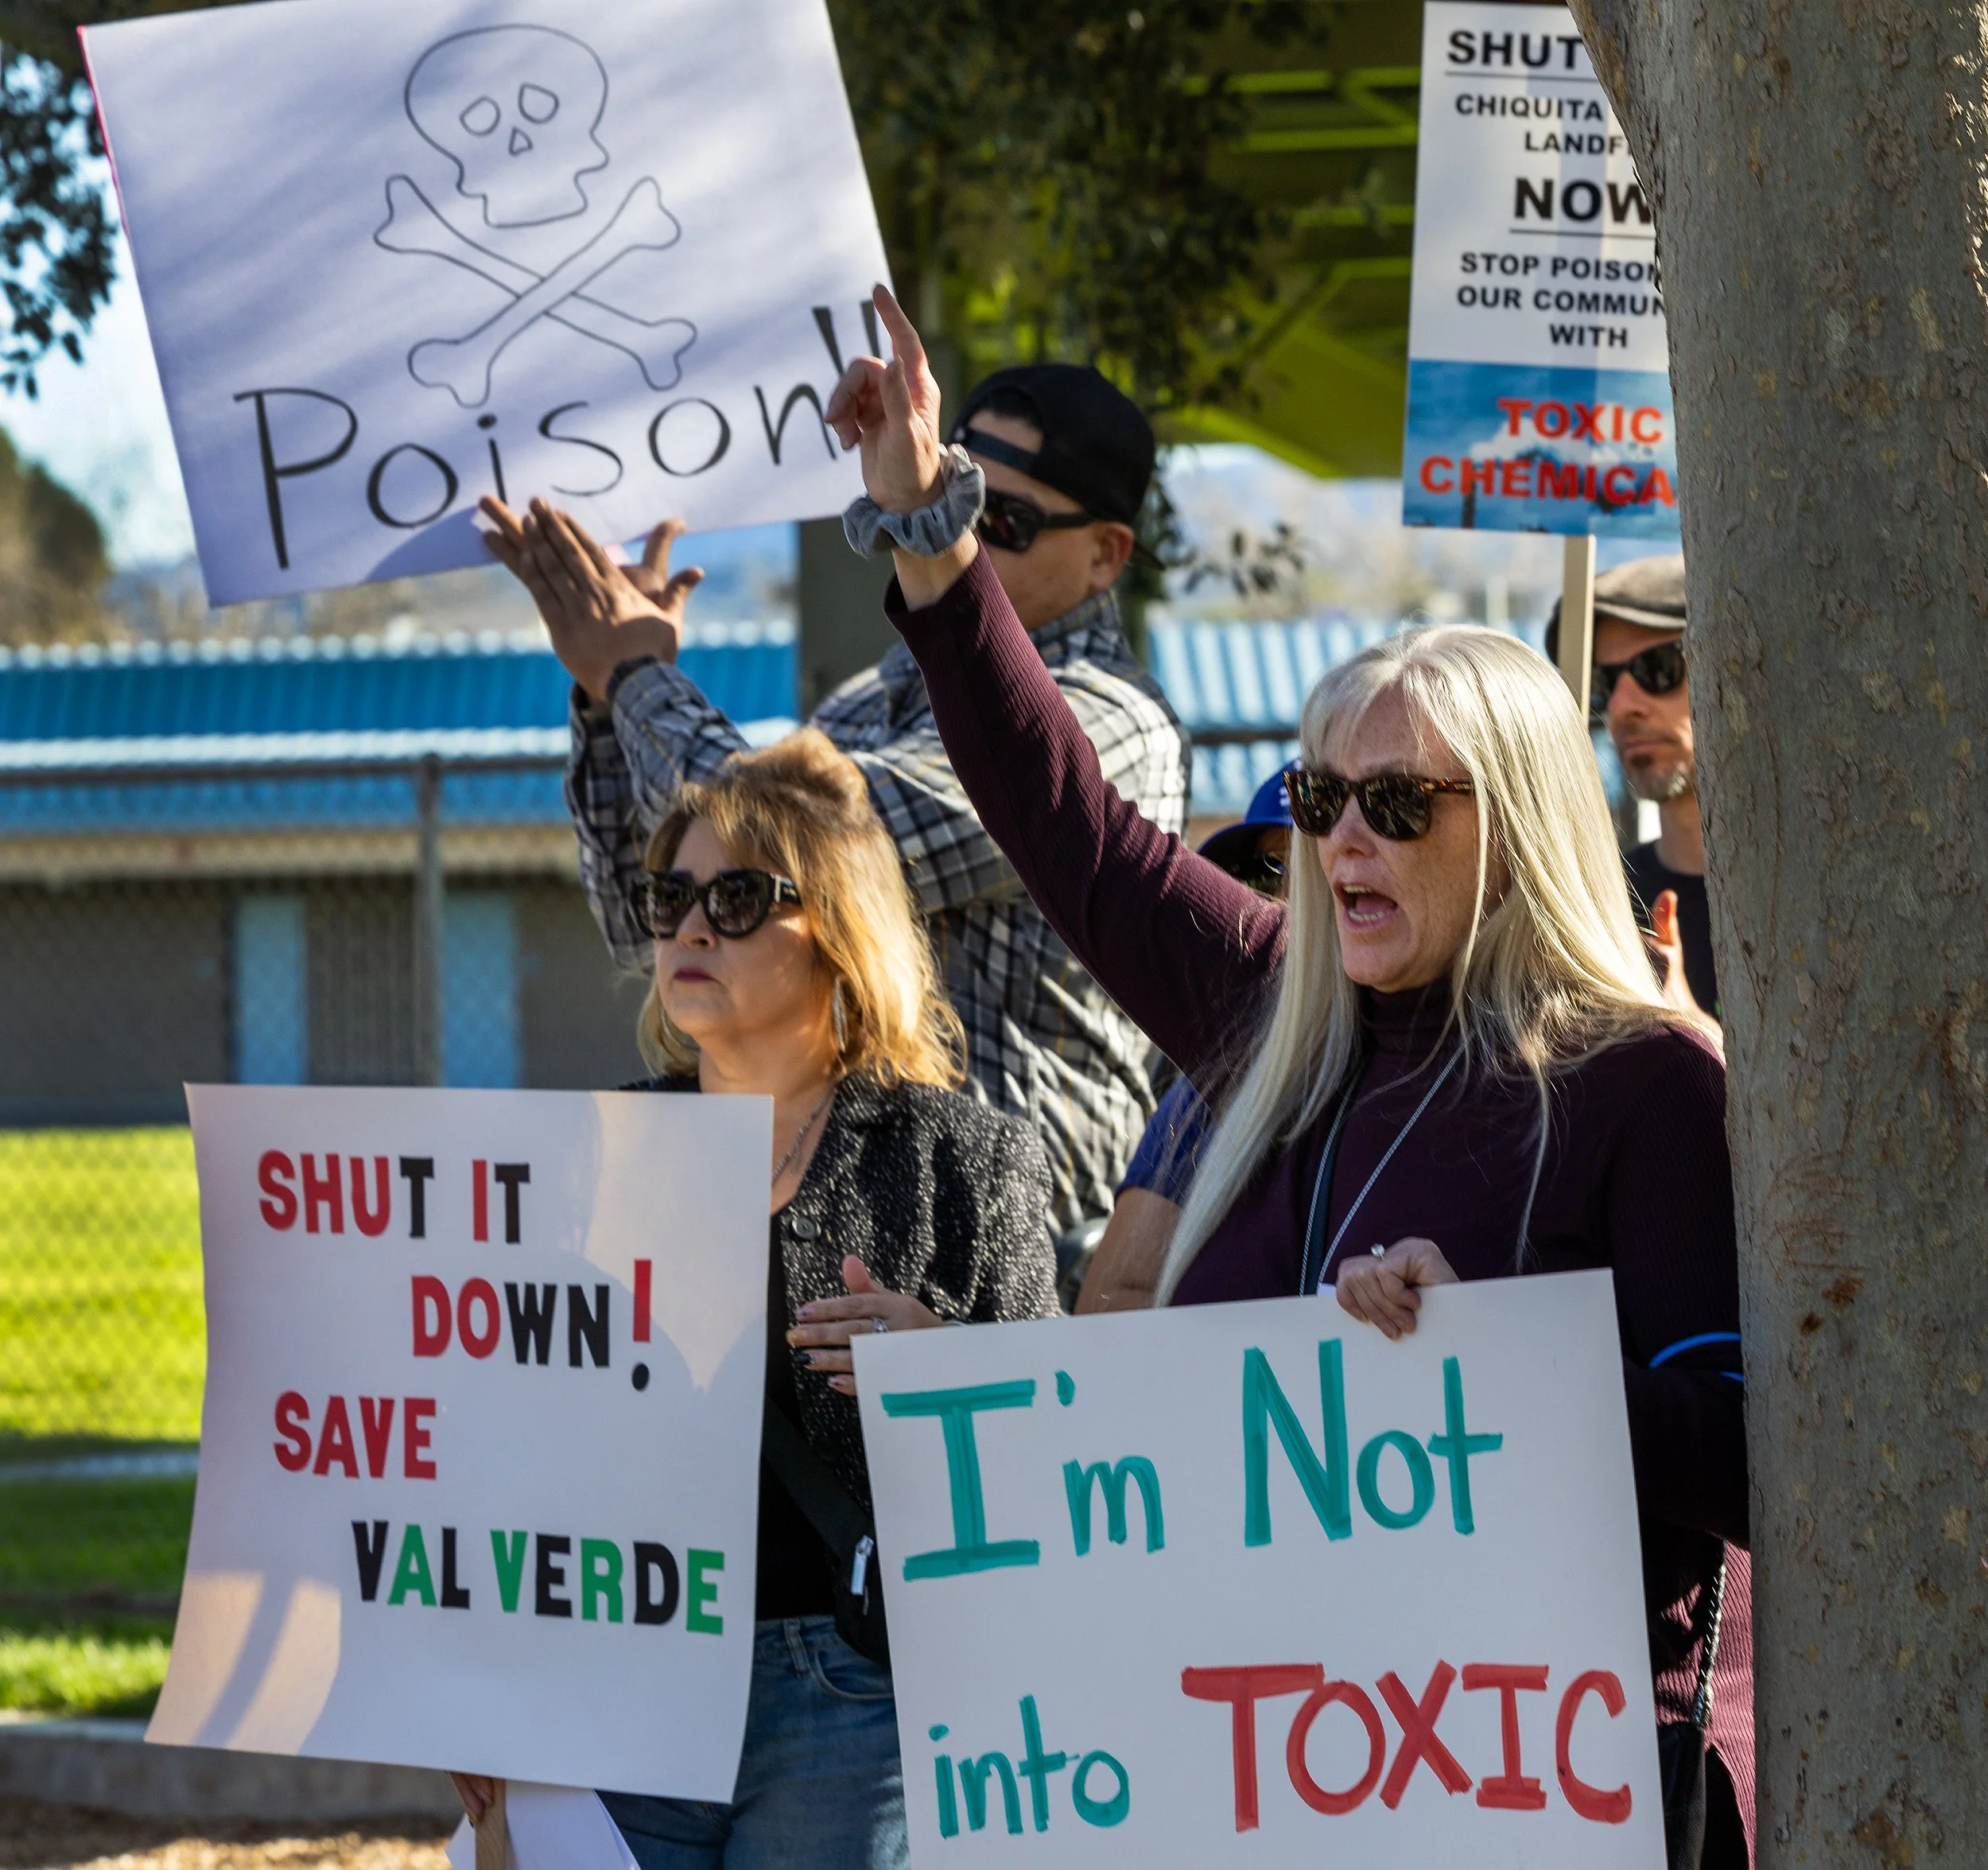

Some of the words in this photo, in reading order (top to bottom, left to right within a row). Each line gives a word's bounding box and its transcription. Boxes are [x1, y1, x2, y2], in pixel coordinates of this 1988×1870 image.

[1447, 29, 1582, 69] SHUT
[1455, 93, 1603, 122] CHIQUITA
[1524, 131, 1630, 156] LANDF
[1514, 177, 1652, 224] NOW
[1461, 251, 1539, 276] STOP
[1457, 285, 1521, 309] OUR
[1534, 290, 1665, 316] COMMUN
[1550, 324, 1628, 348] WITH
[1497, 397, 1663, 445] TOXIC
[1419, 455, 1679, 508] CHEMICA
[257, 1149, 434, 1239] SHUT
[472, 1159, 530, 1244] IT
[410, 1258, 652, 1392] DOWN!
[273, 1390, 437, 1480] SAVE
[880, 1370, 1165, 1581] I'm
[1243, 1338, 1503, 1548] Not
[351, 1519, 471, 1610] VAL
[489, 1529, 725, 1635] VERDE
[928, 1695, 1130, 1839] into
[1180, 1659, 1633, 1833] TOXIC
